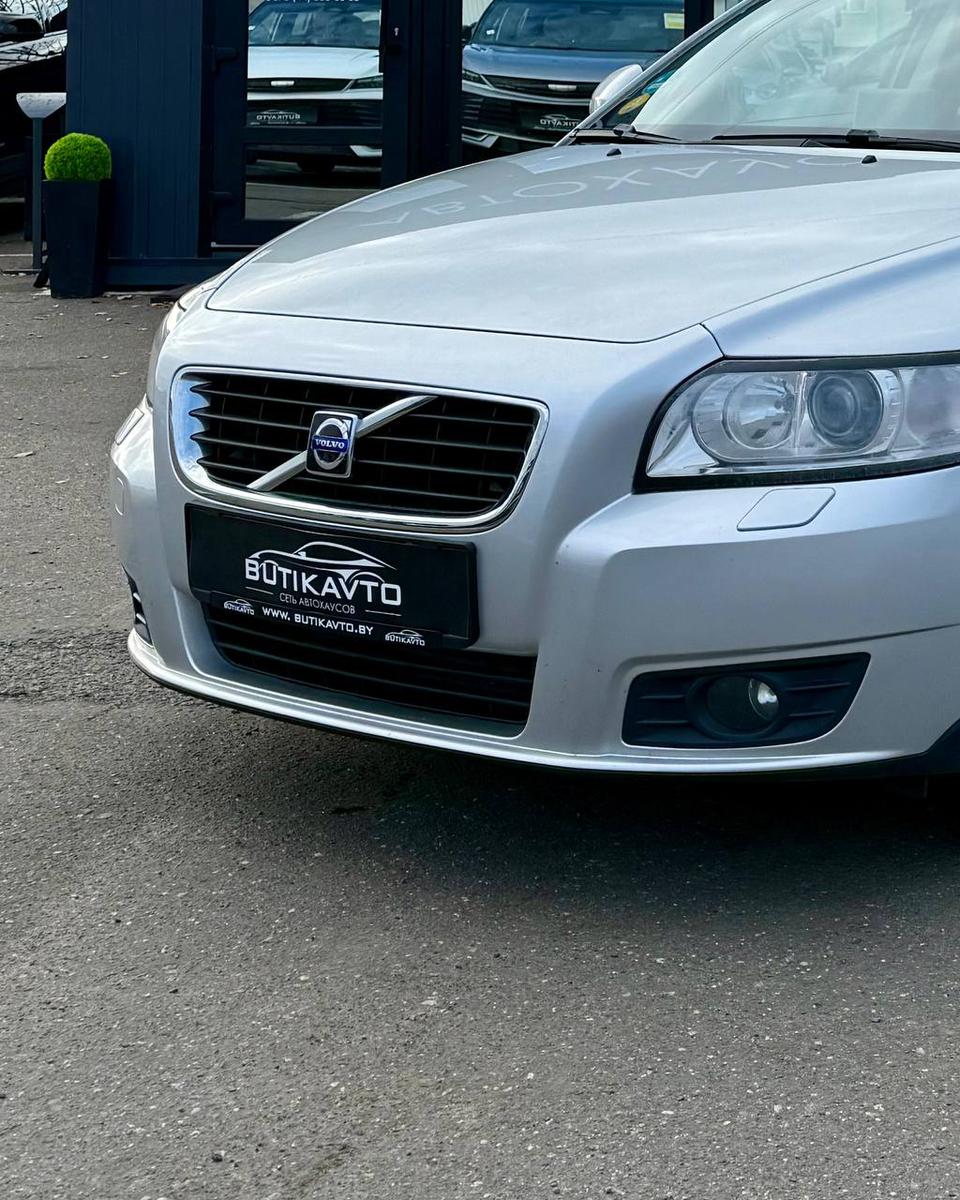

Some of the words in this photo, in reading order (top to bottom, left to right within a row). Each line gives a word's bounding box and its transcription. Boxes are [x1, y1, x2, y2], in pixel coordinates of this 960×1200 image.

[315, 438, 345, 449] VOLVO
[245, 558, 402, 606] BUTIKAVTO
[223, 602, 255, 616] BUTIKAVTO
[279, 592, 298, 605] СЕТЬ
[298, 597, 356, 615] АВТОХАУСОВ
[384, 633, 426, 647] BUTIKAVTO
